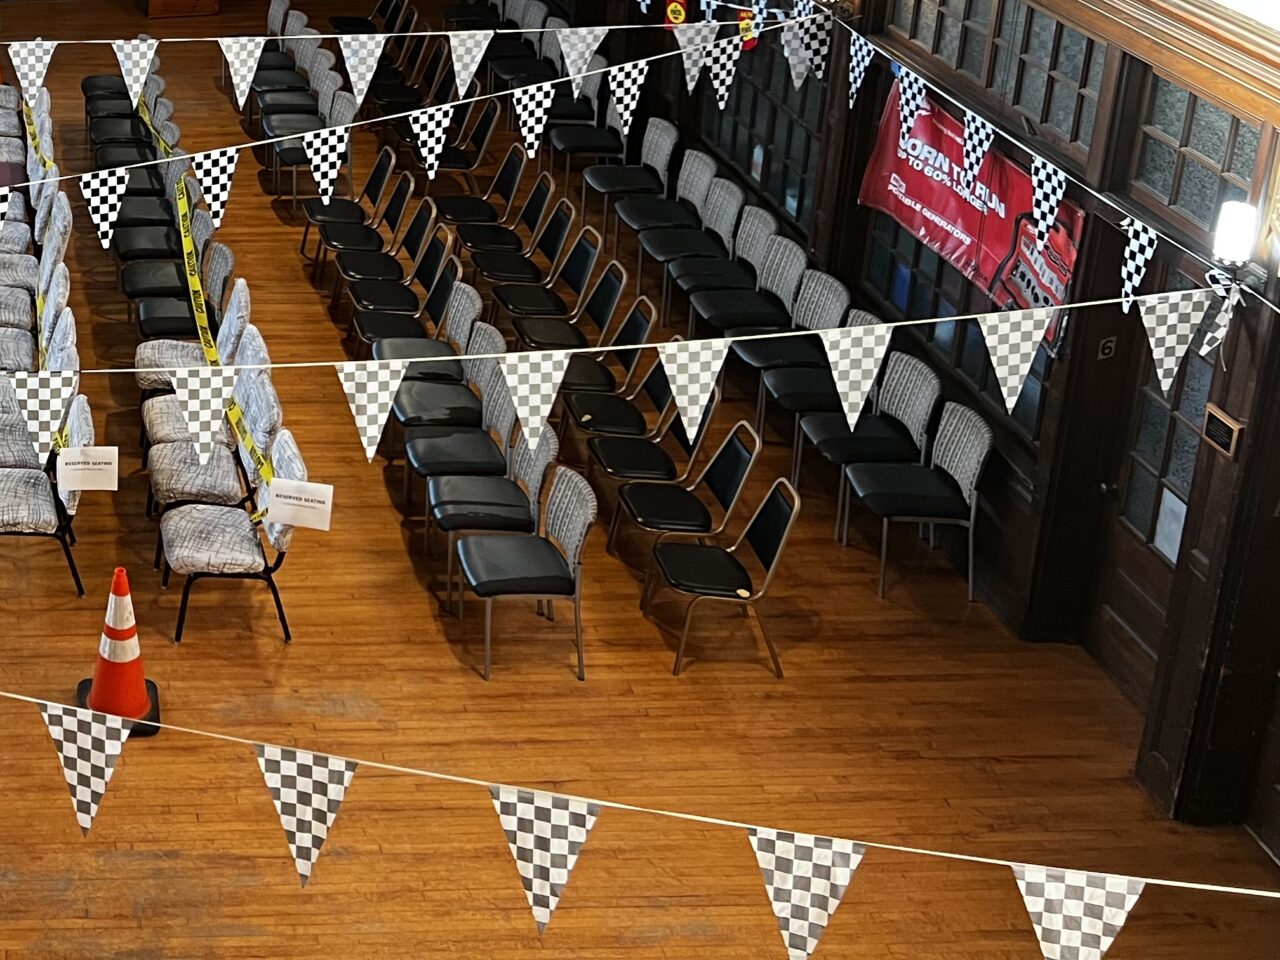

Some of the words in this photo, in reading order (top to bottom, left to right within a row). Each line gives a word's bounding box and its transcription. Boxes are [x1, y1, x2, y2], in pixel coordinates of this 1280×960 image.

[908, 157, 923, 171] TO
[924, 167, 952, 187] 60%
[975, 182, 1006, 219] RUN
[181, 211, 190, 238] CAUTION
[921, 206, 972, 245] GENERATORS
[186, 249, 197, 276] CAUTION
[192, 289, 204, 313] CAUTION
[1101, 340, 1113, 356] 6
[275, 493, 302, 502] RESERVED
[303, 497, 326, 506] SEATING
